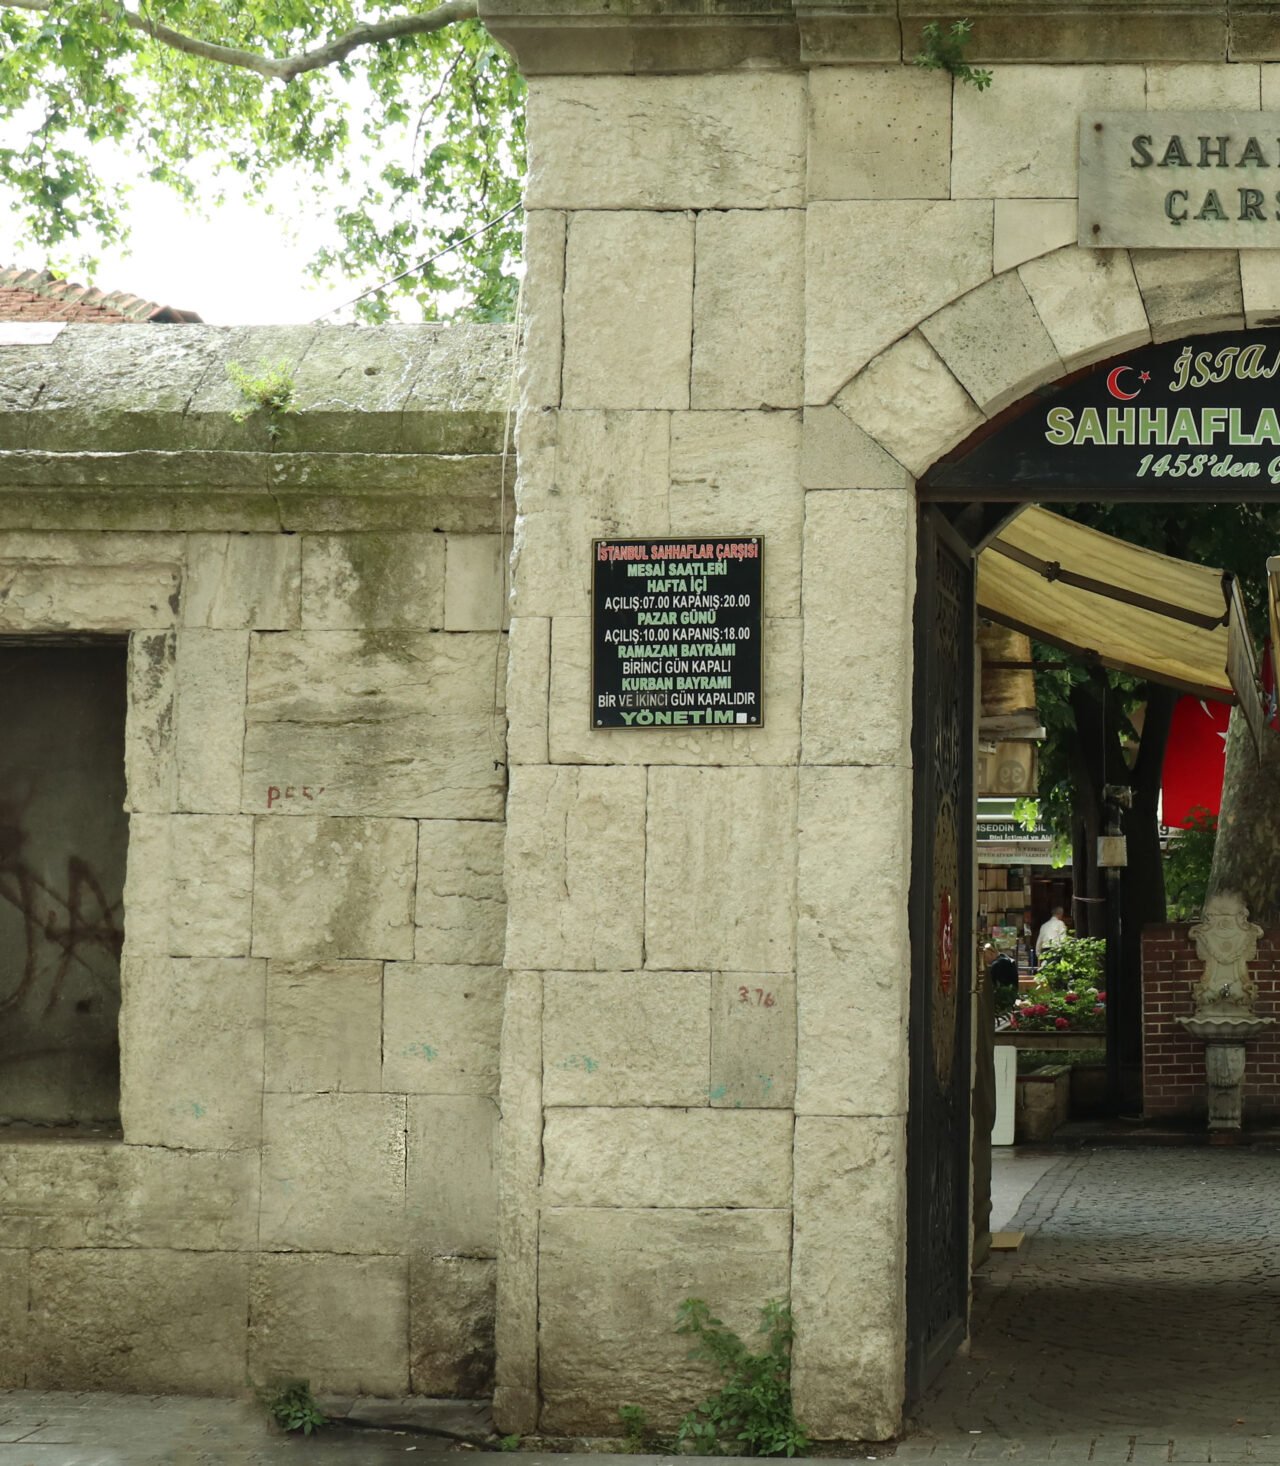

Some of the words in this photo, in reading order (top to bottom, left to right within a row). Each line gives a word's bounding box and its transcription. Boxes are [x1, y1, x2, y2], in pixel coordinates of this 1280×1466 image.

[1136, 453, 1261, 479] 1458'den
[651, 544, 713, 559] SAHHAFLAR
[716, 543, 758, 562] ÇARŞISI
[627, 561, 665, 577] MESAİ
[669, 560, 727, 576] SAATLERİ
[647, 579, 687, 593] HAFTA
[690, 576, 707, 594] İÇİ
[637, 612, 678, 625] PAZAR
[680, 609, 717, 624] GÜNÜ
[617, 644, 678, 659] RAMAZAN
[681, 643, 736, 657] BAYRAMI
[622, 658, 662, 675] BİRİNCİ
[665, 658, 689, 674] GÜN
[691, 660, 731, 673] KAPALI
[622, 676, 673, 691] KURBAN
[676, 675, 732, 690] BAYRAMI
[598, 692, 616, 708] BİR
[619, 694, 633, 707] VE
[635, 691, 668, 706] İKİNCİ
[671, 690, 695, 706] GÜN
[697, 692, 755, 706] KAPALIDIR
[619, 707, 735, 726] YÖNETİM
